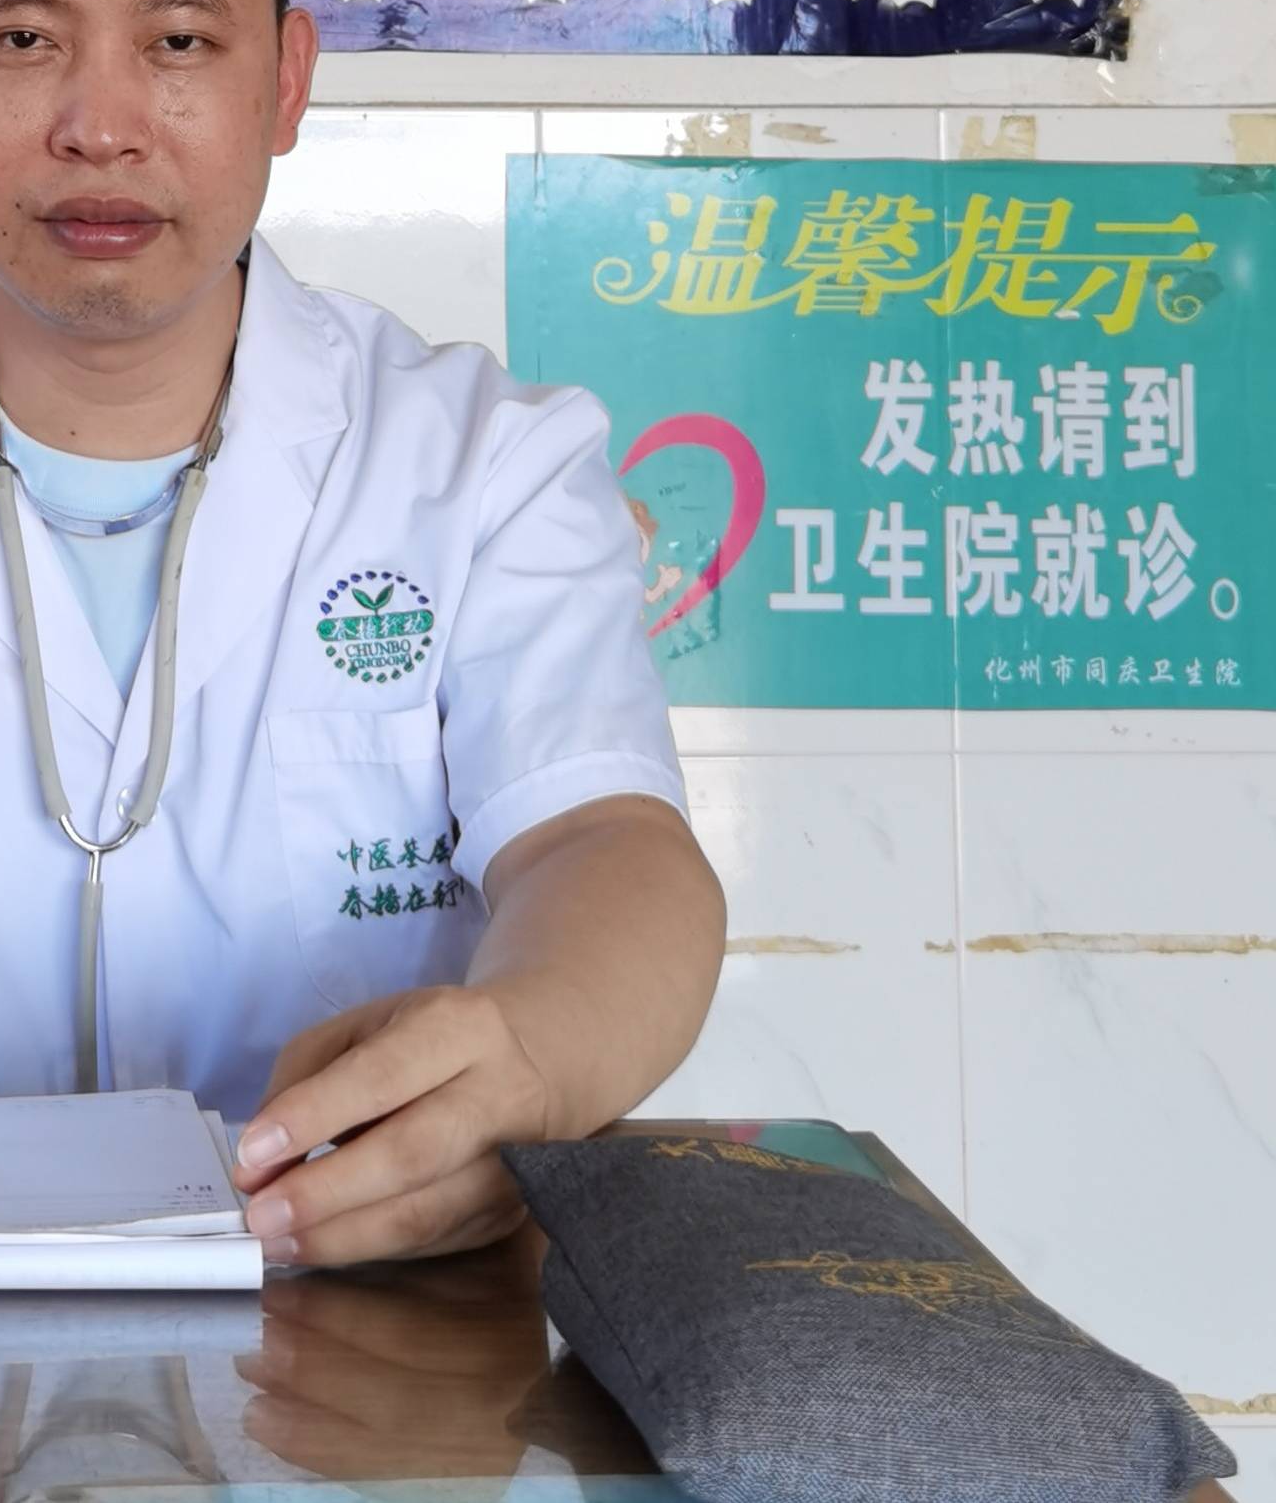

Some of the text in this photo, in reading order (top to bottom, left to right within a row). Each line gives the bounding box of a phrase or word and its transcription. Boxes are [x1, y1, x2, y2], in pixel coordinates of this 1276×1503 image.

[593, 190, 1218, 334] 温馨提示
[860, 358, 1195, 478] 发热请到
[769, 501, 1239, 621] 卫生院就诊。
[984, 654, 1241, 686] 化州市同庆卫生院
